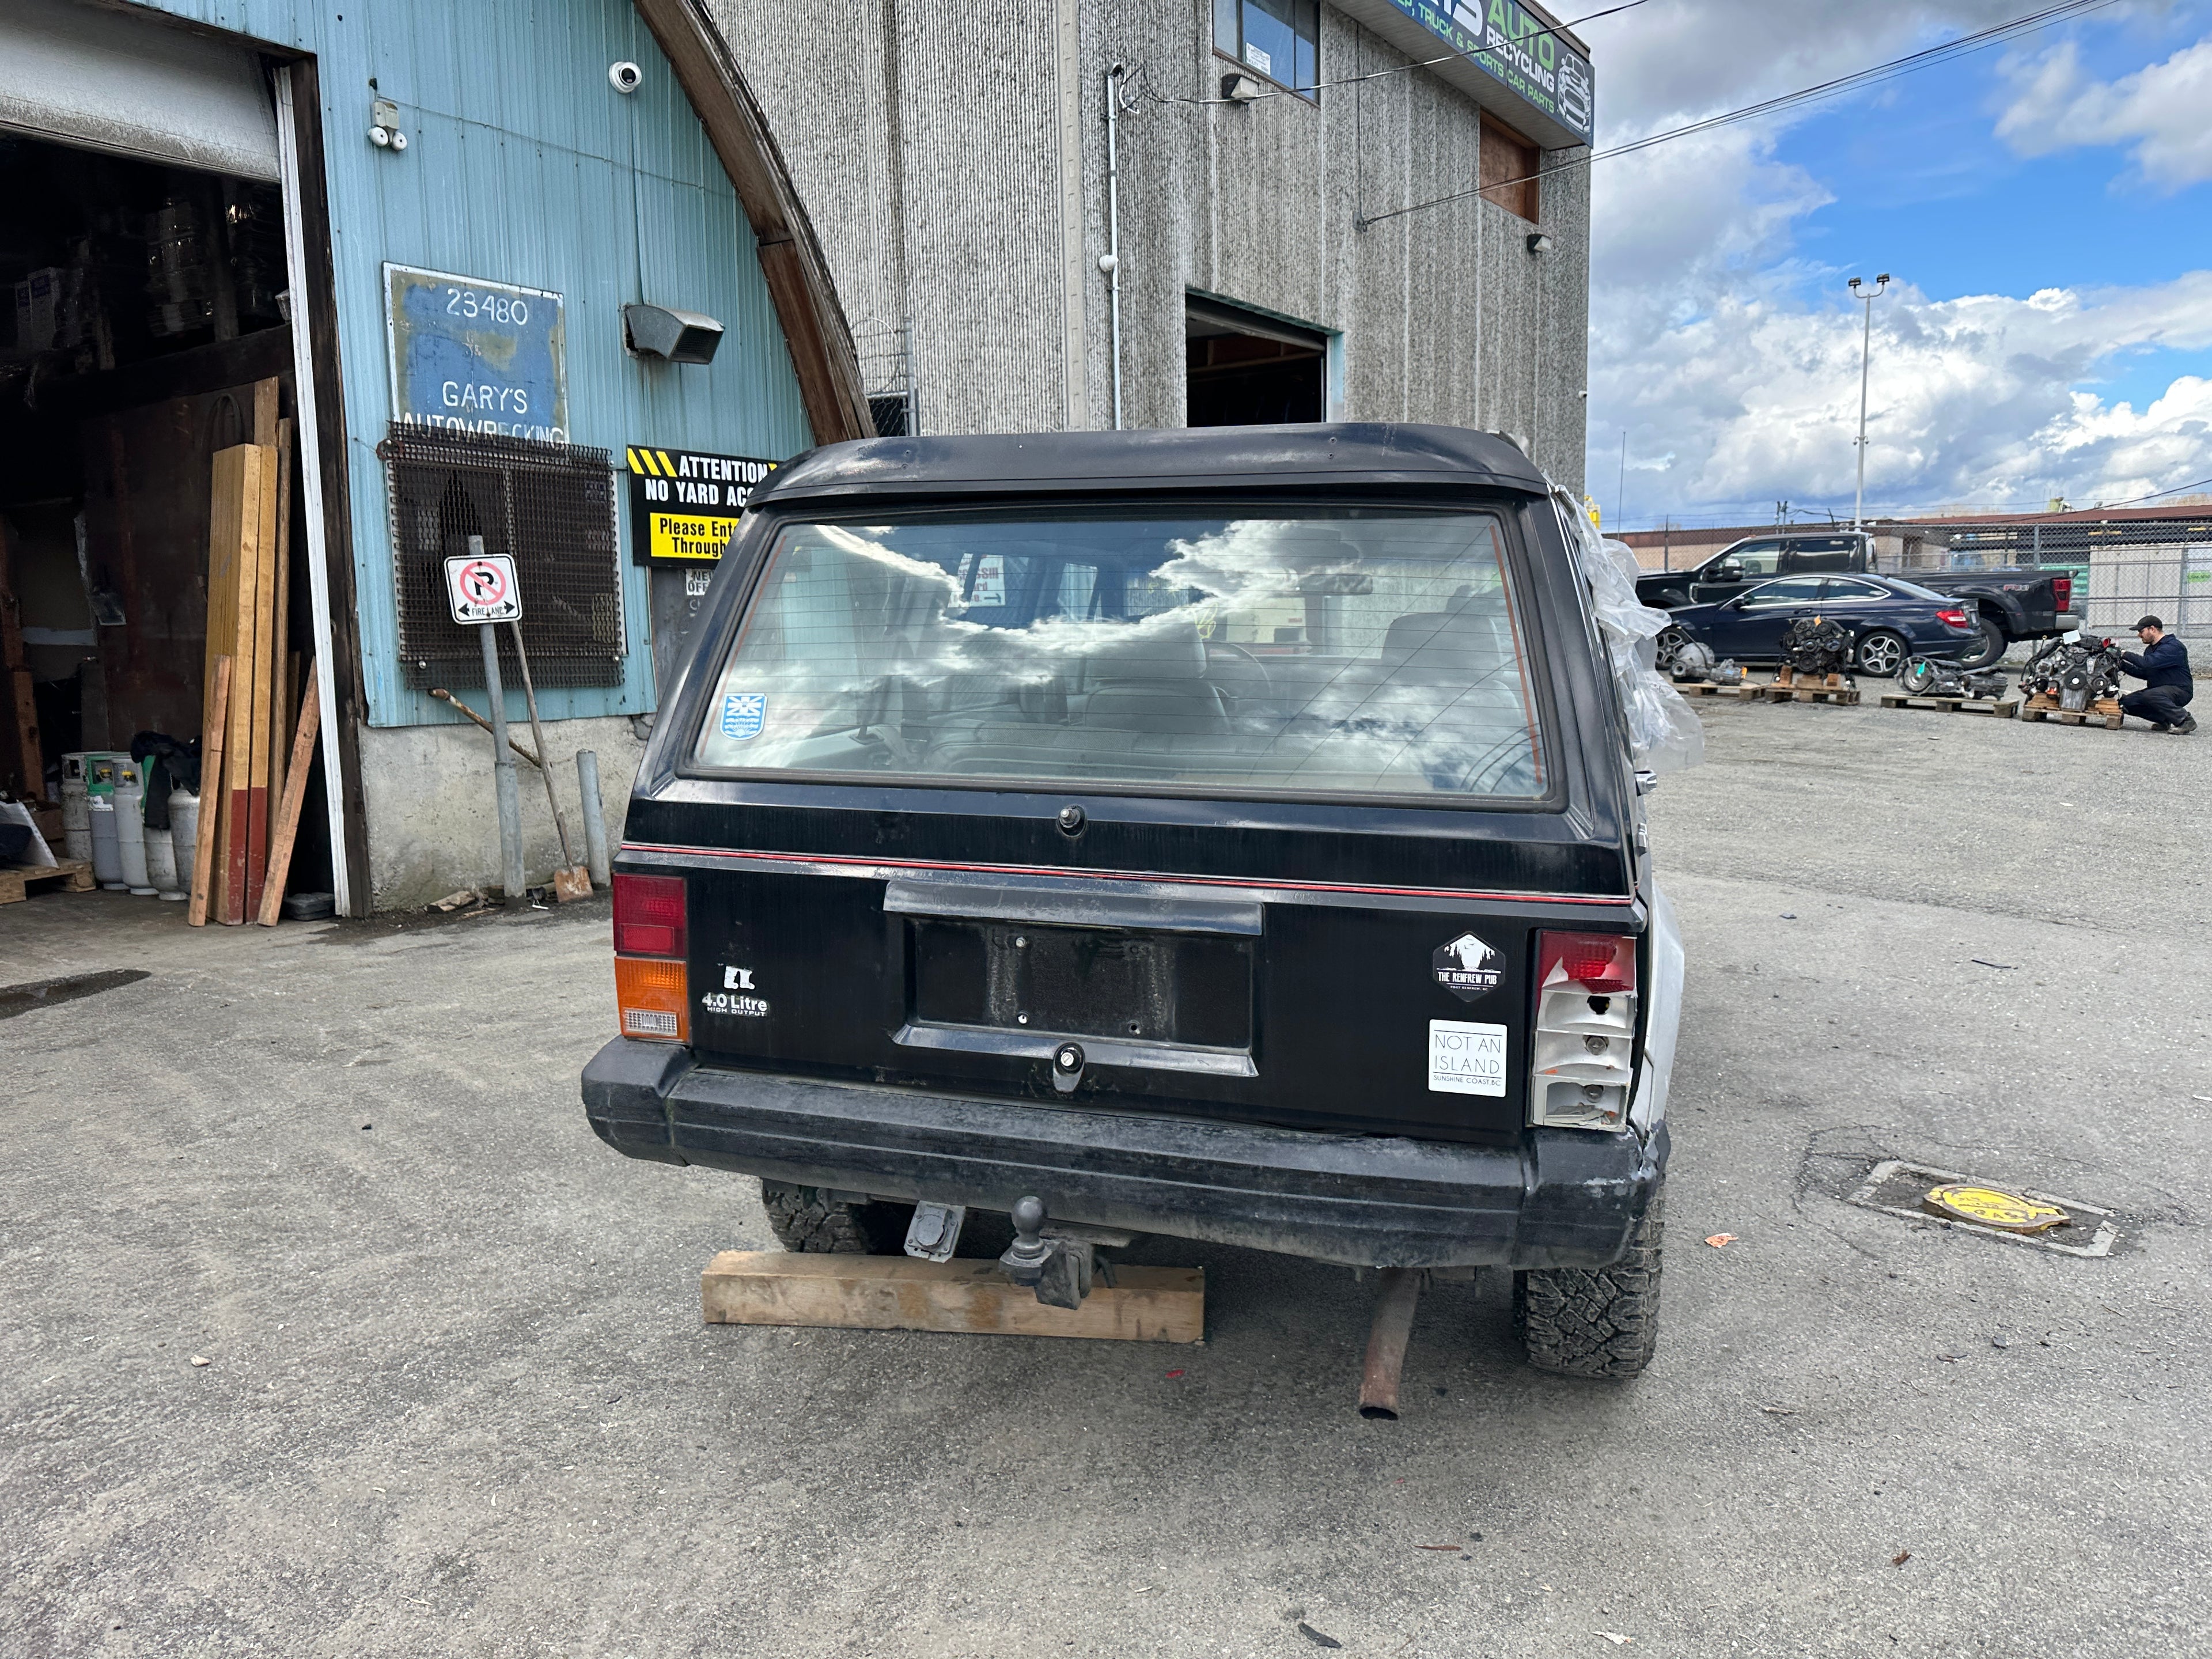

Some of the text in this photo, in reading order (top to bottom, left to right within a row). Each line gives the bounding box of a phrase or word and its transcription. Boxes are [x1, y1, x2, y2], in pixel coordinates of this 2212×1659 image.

[1487, 0, 1555, 71] AUTO
[1418, 2, 1453, 41] TRUCK
[1456, 31, 1464, 48] &
[1467, 39, 1505, 78] SPORTS
[1507, 69, 1526, 91] CAR
[1528, 85, 1555, 114] PARTS
[1486, 25, 1555, 93] RECYCLING
[446, 288, 528, 325] 23480
[442, 381, 528, 414] GARY'S
[679, 455, 768, 483] ATTENTION
[645, 479, 669, 501] NO
[676, 481, 719, 505] YARD
[660, 517, 705, 536] Please
[472, 608, 486, 616] FIRE
[1438, 971, 1497, 984] THE RENFREW PUB
[702, 993, 767, 1012] 4.0 Litre
[1435, 1034, 1501, 1053] NOT AN
[1435, 1055, 1499, 1074] ISLAND
[1433, 1074, 1464, 1083] SUNSHINE
